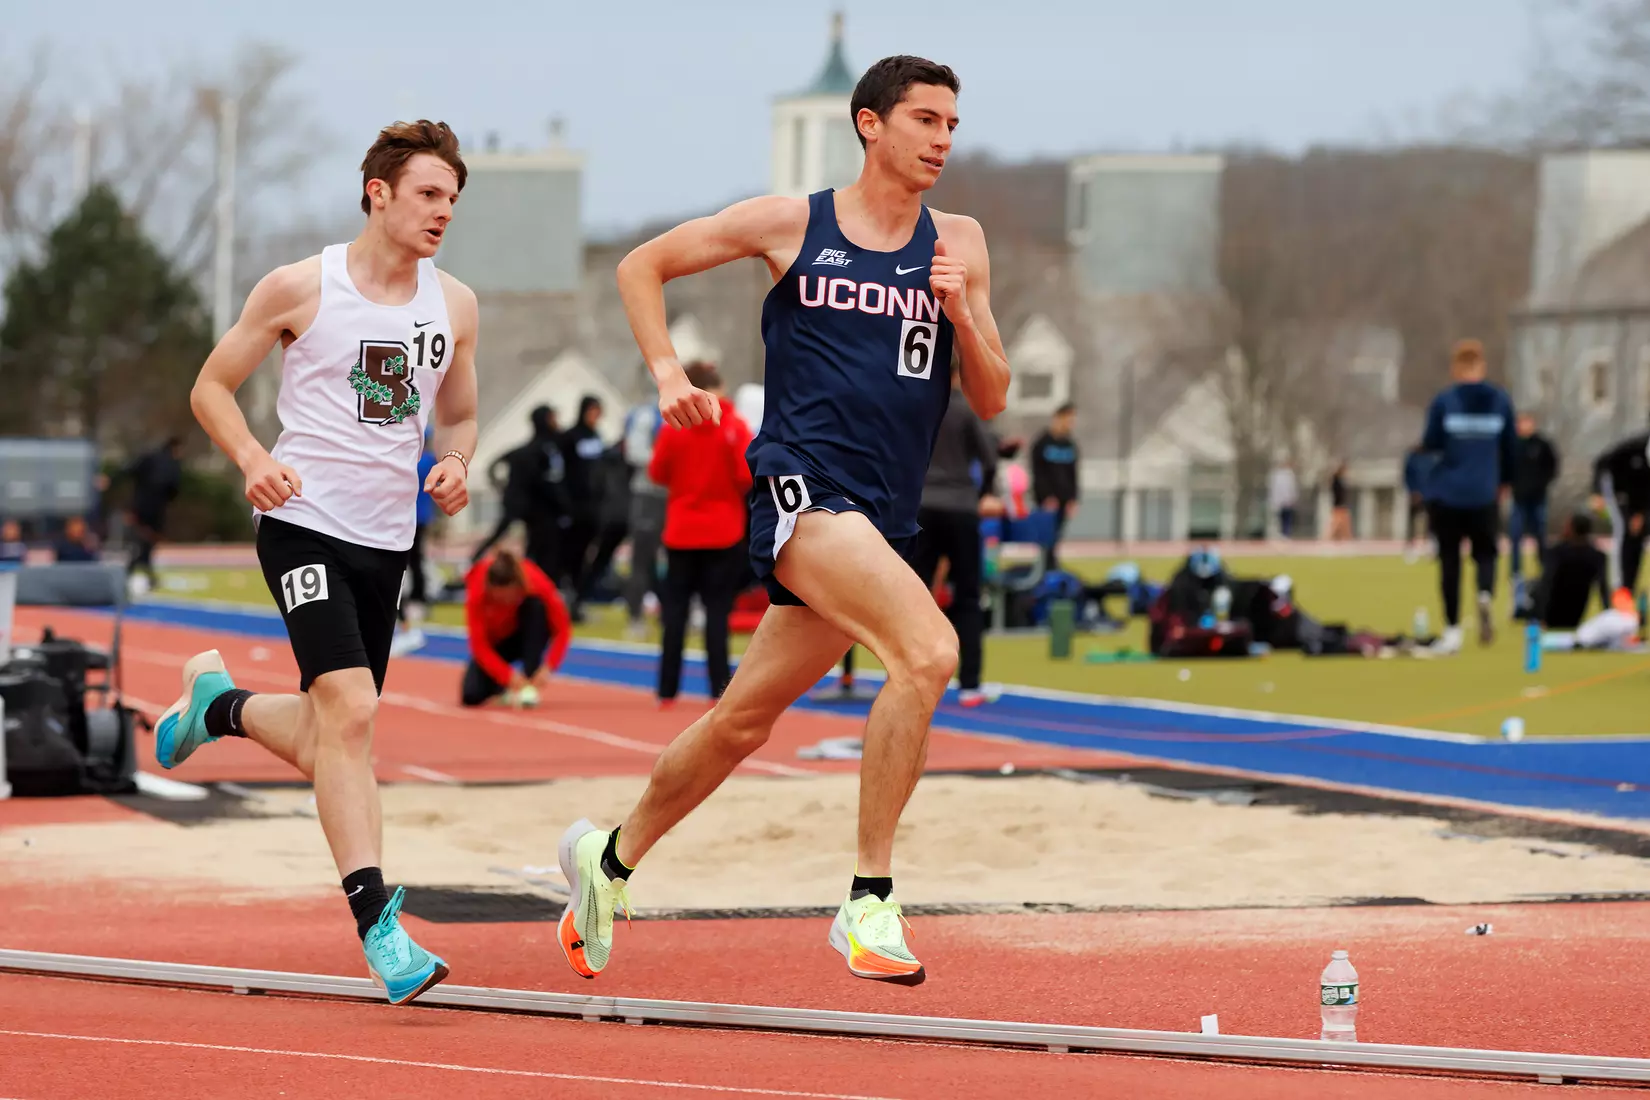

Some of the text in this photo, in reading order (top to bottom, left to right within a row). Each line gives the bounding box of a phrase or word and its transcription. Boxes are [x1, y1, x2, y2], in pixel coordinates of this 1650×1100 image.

[815, 255, 853, 266] EAST
[820, 248, 847, 258] BIG
[799, 275, 939, 323] UCONN
[413, 331, 446, 369] 19
[904, 325, 931, 375] 6
[774, 476, 802, 513] 6
[285, 567, 321, 607] 19
